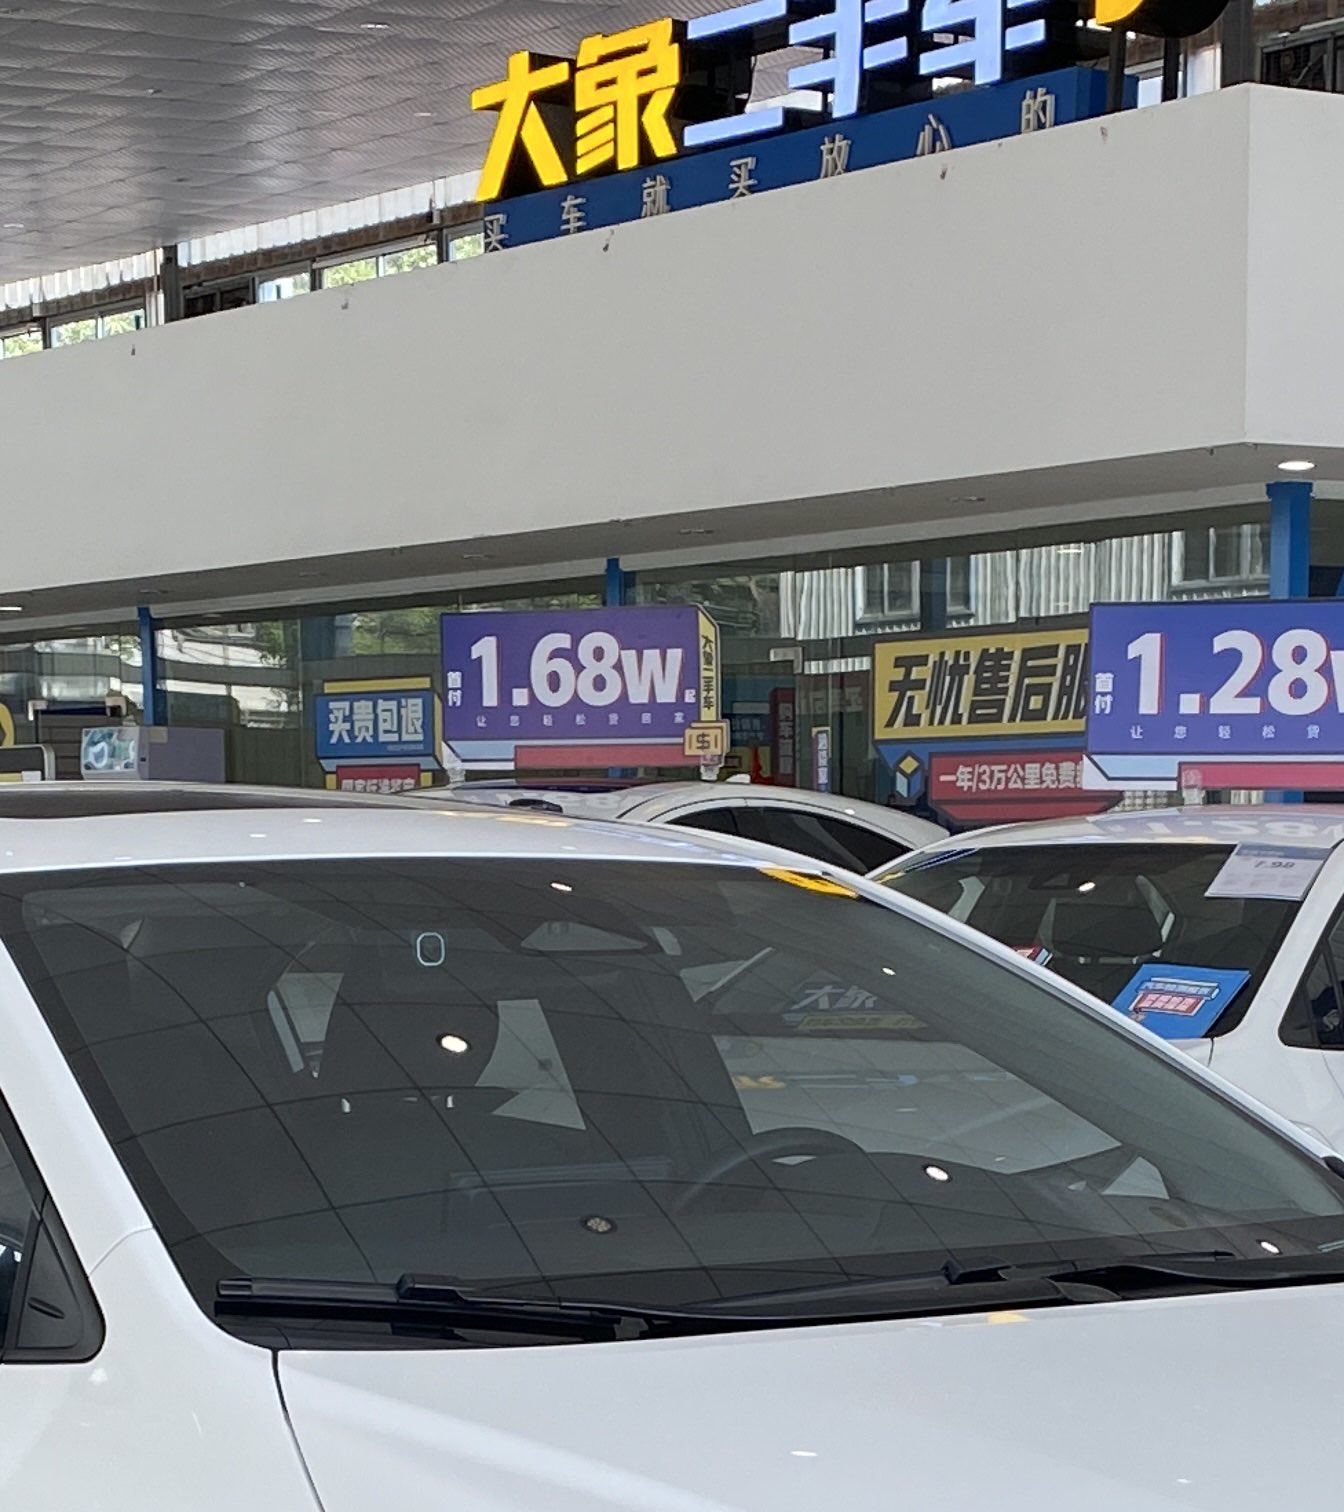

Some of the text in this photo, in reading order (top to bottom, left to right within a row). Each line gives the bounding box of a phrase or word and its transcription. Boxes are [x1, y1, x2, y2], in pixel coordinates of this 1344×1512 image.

[470, 0, 1047, 203] 大象二手车
[482, 86, 1056, 253] 买车就买放心的
[328, 697, 425, 744] 买贵包退
[884, 642, 1089, 729] 无忧售后服
